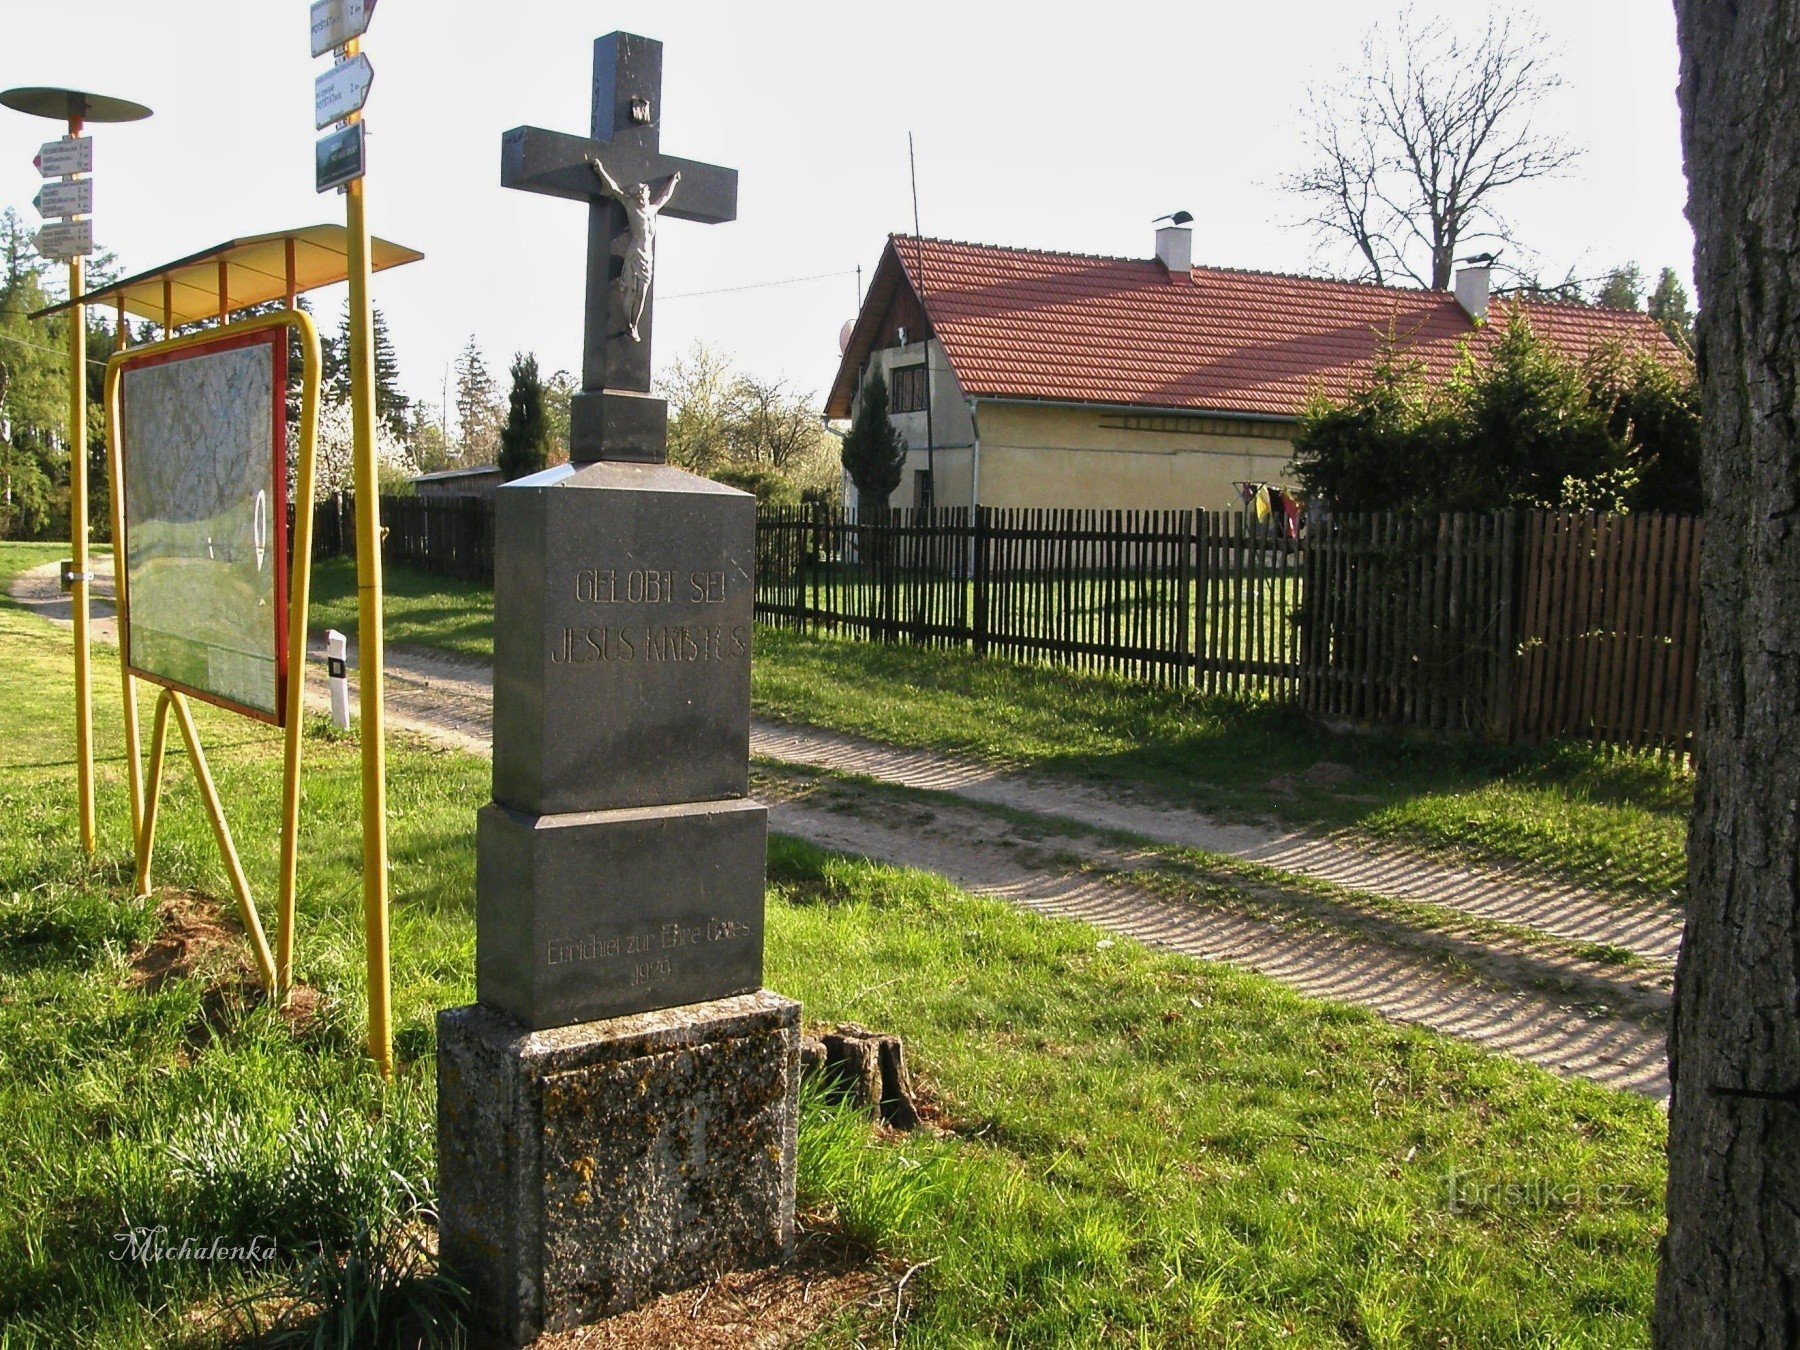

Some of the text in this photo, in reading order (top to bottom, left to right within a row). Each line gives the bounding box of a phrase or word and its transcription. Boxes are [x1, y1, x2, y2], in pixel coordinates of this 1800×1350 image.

[576, 569, 727, 603] GELOBT SEI
[551, 626, 635, 664] JESUS
